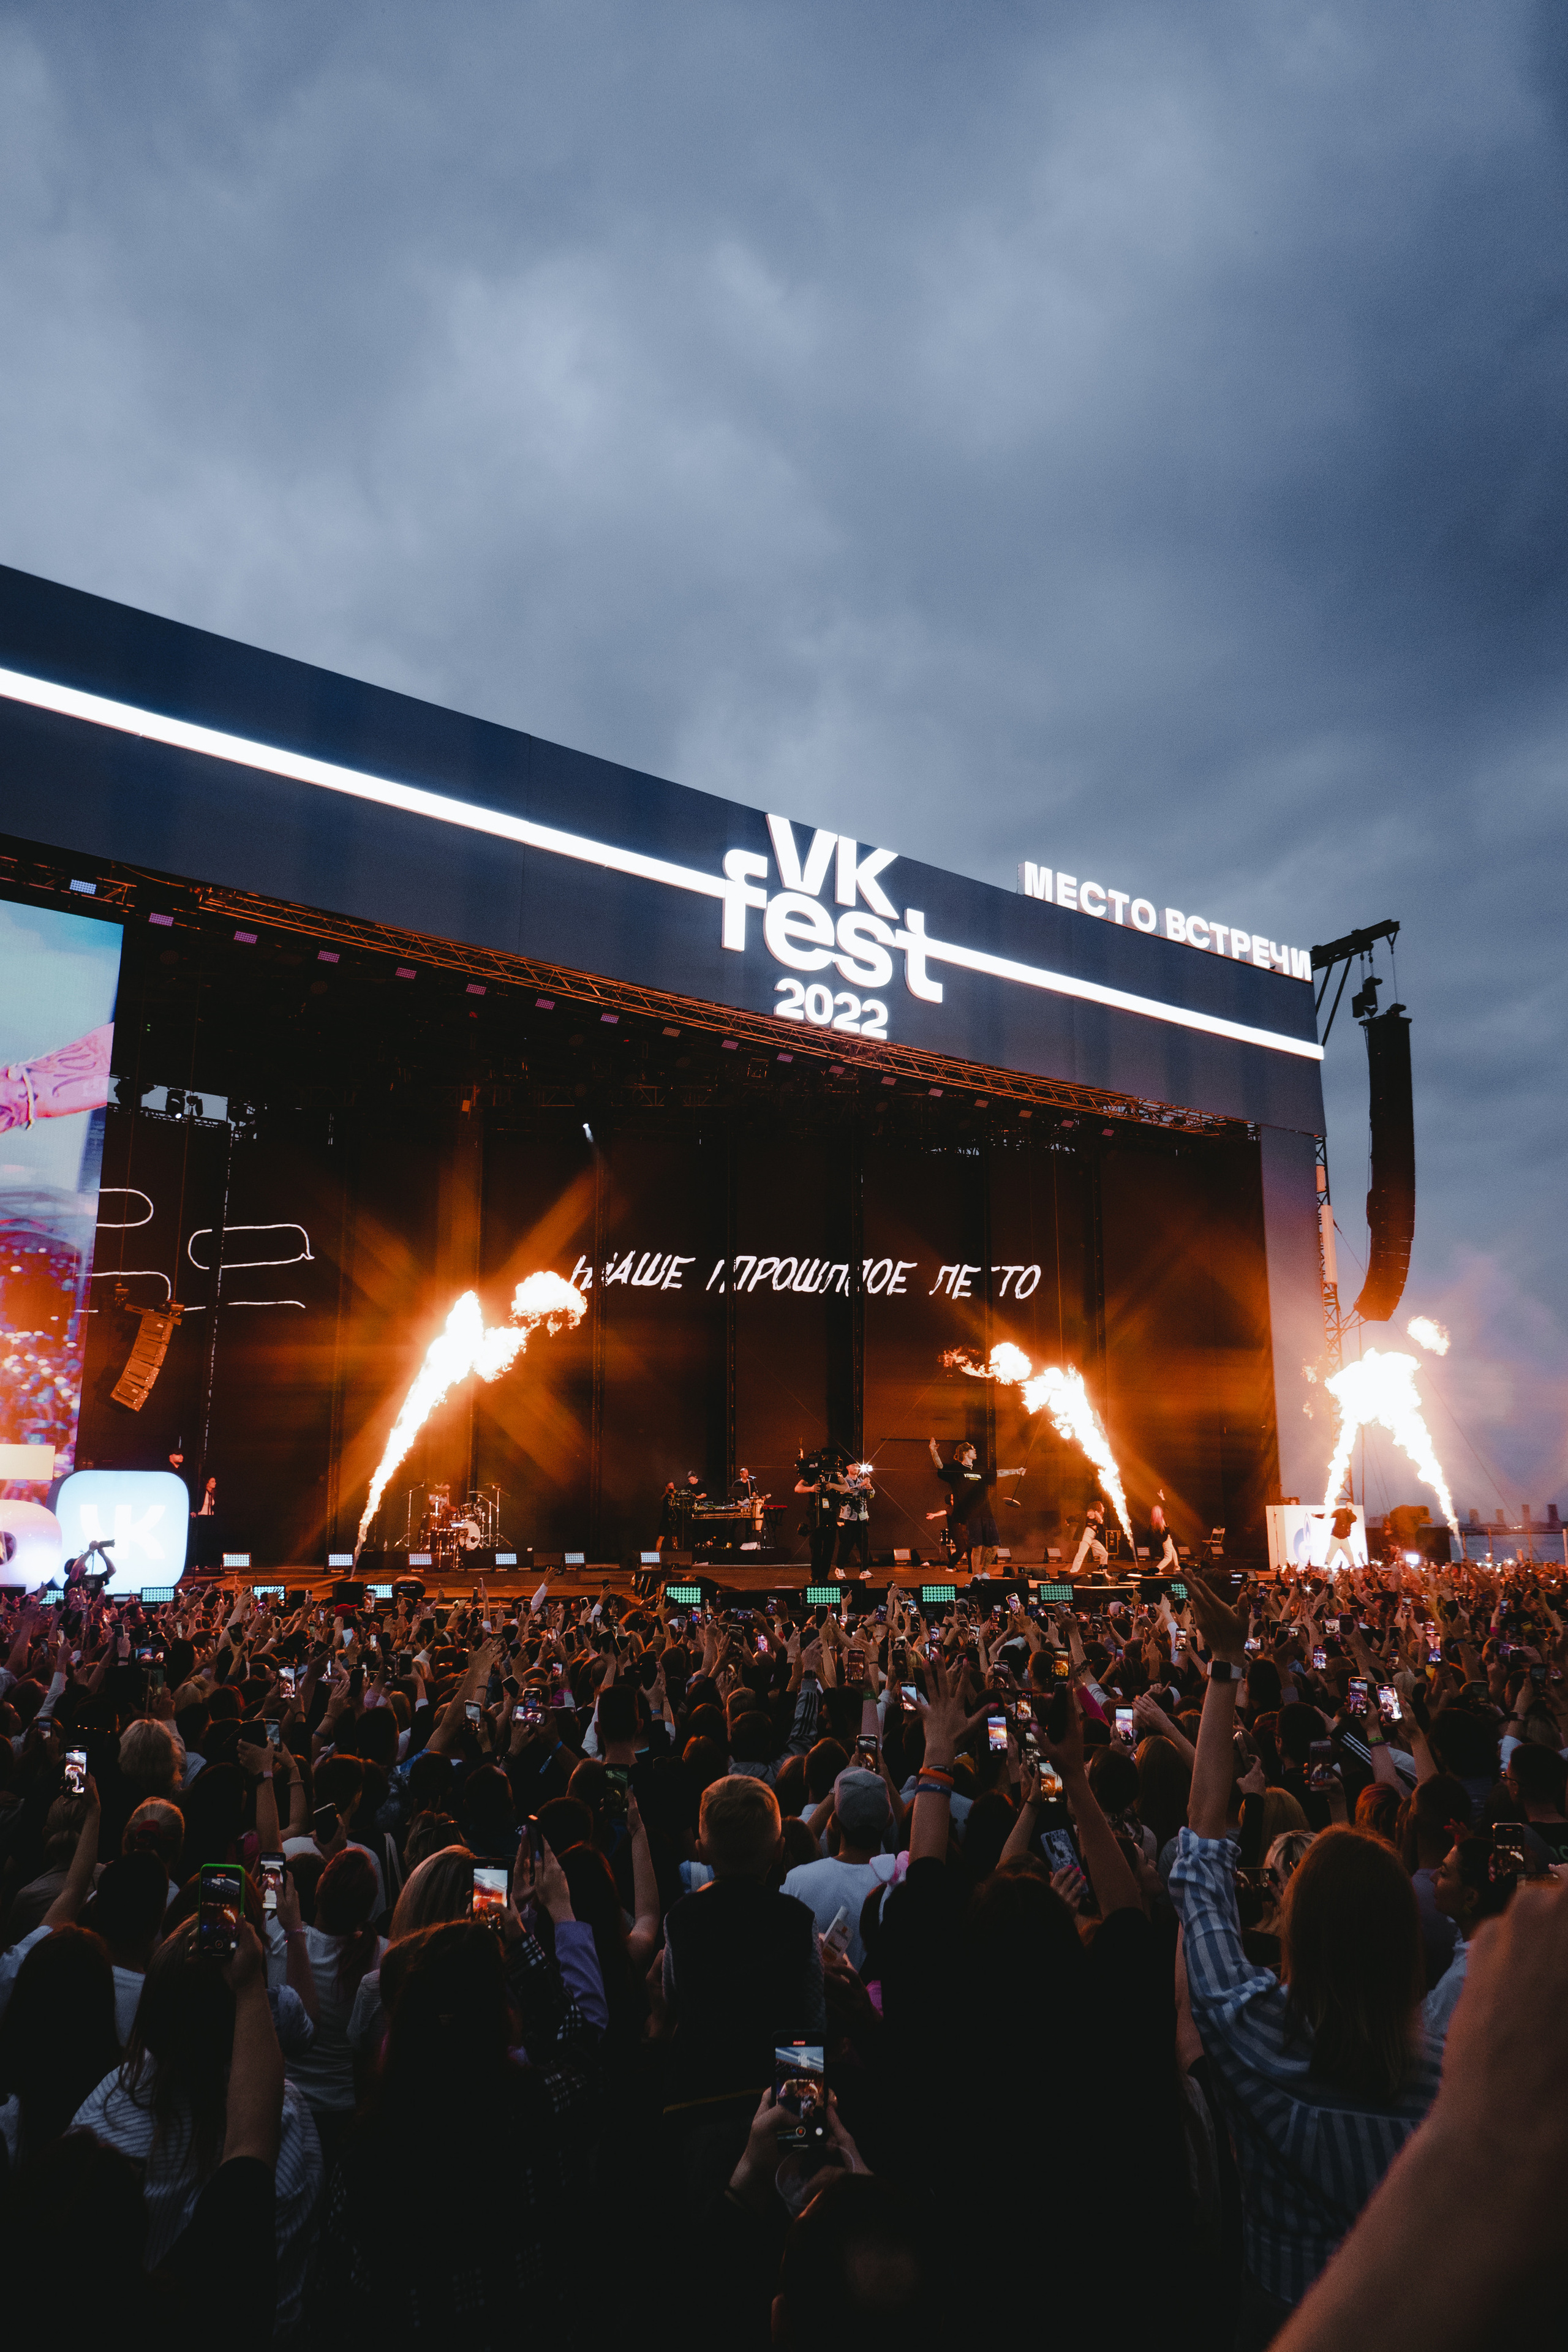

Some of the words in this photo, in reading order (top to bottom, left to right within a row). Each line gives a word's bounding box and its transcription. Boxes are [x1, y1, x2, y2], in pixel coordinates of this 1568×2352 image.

[766, 813, 899, 919] VK
[722, 849, 943, 1003] fest
[1018, 861, 1157, 933] МЕСТО
[1161, 907, 1312, 981] ВСТРЕЧИ
[774, 978, 889, 1039] 2022
[80, 1504, 165, 1560] VK
